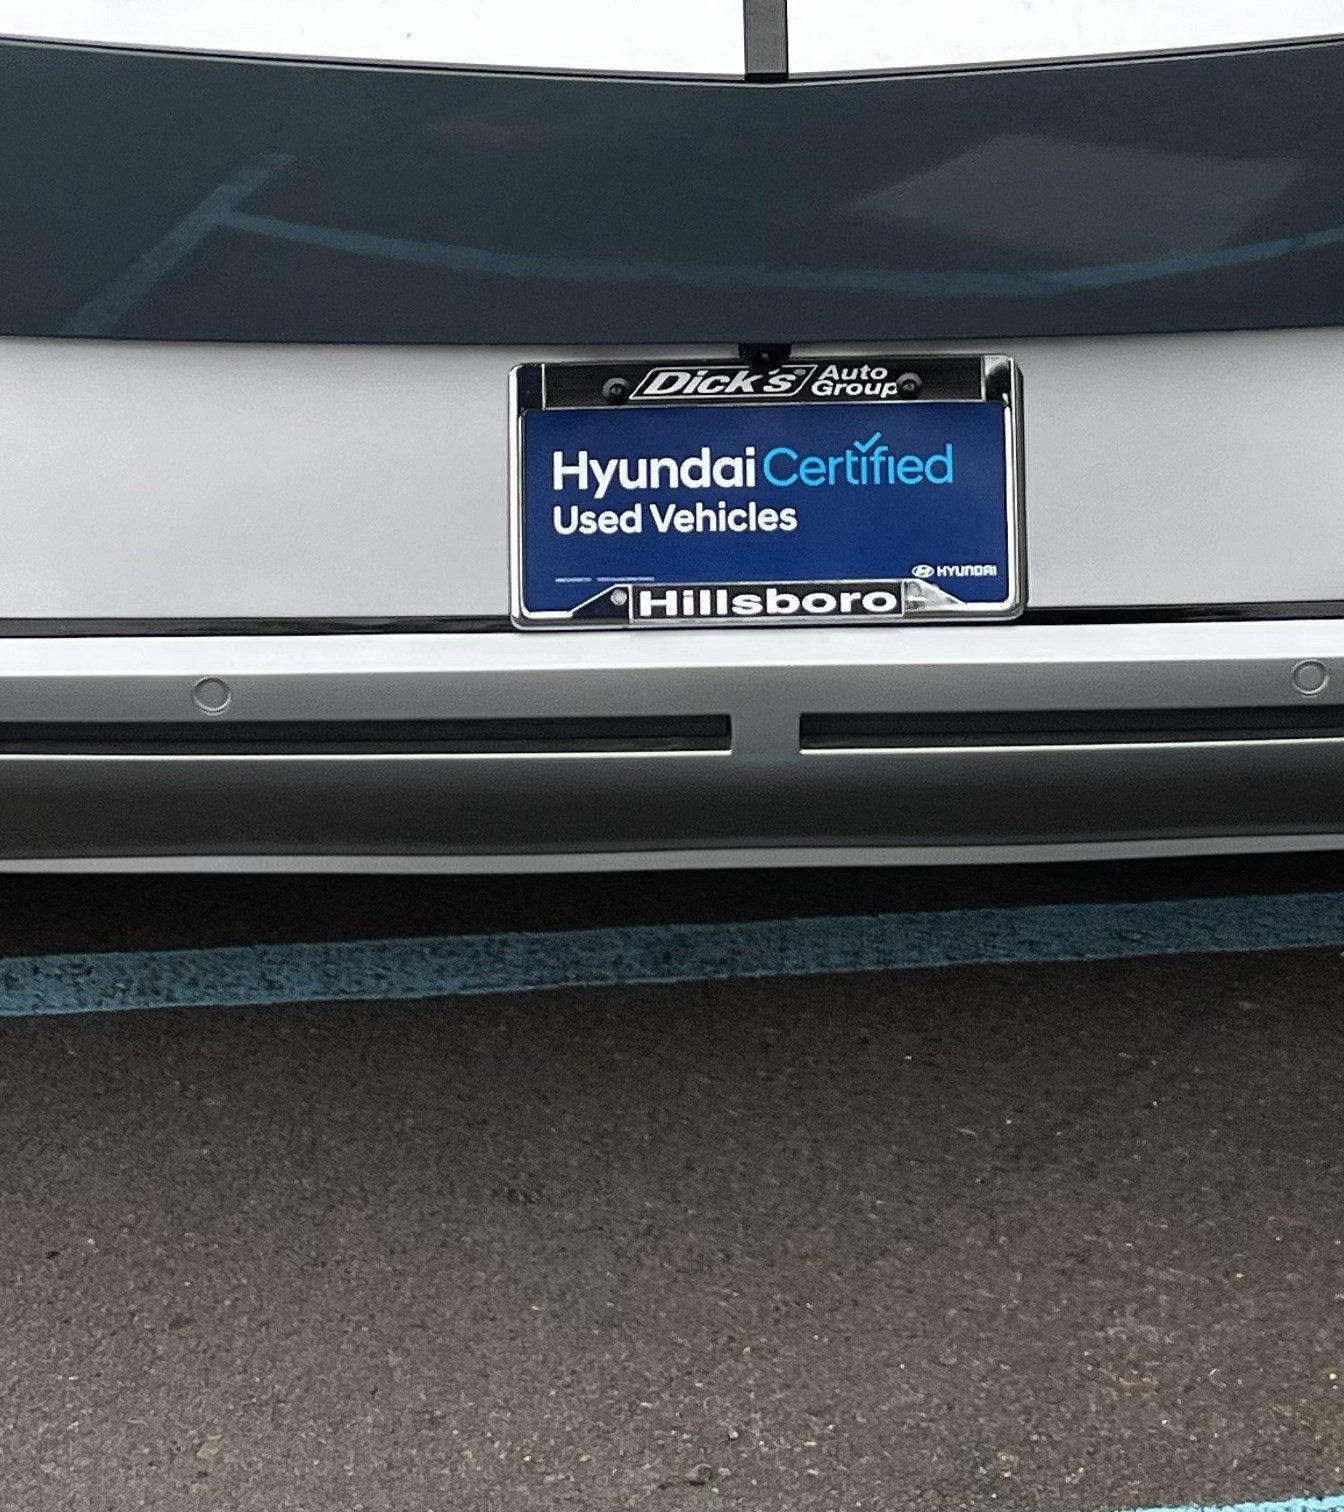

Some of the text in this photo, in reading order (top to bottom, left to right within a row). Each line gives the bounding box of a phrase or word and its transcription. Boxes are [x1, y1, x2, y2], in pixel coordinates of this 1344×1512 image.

[643, 369, 797, 394] Dick's
[818, 364, 888, 380] Auto
[811, 380, 898, 398] Group
[553, 443, 954, 498] Hyundai Certified
[553, 501, 797, 534] Used Vehicles
[936, 565, 997, 577] HYUNDAI
[640, 589, 898, 616] Hillsboro
